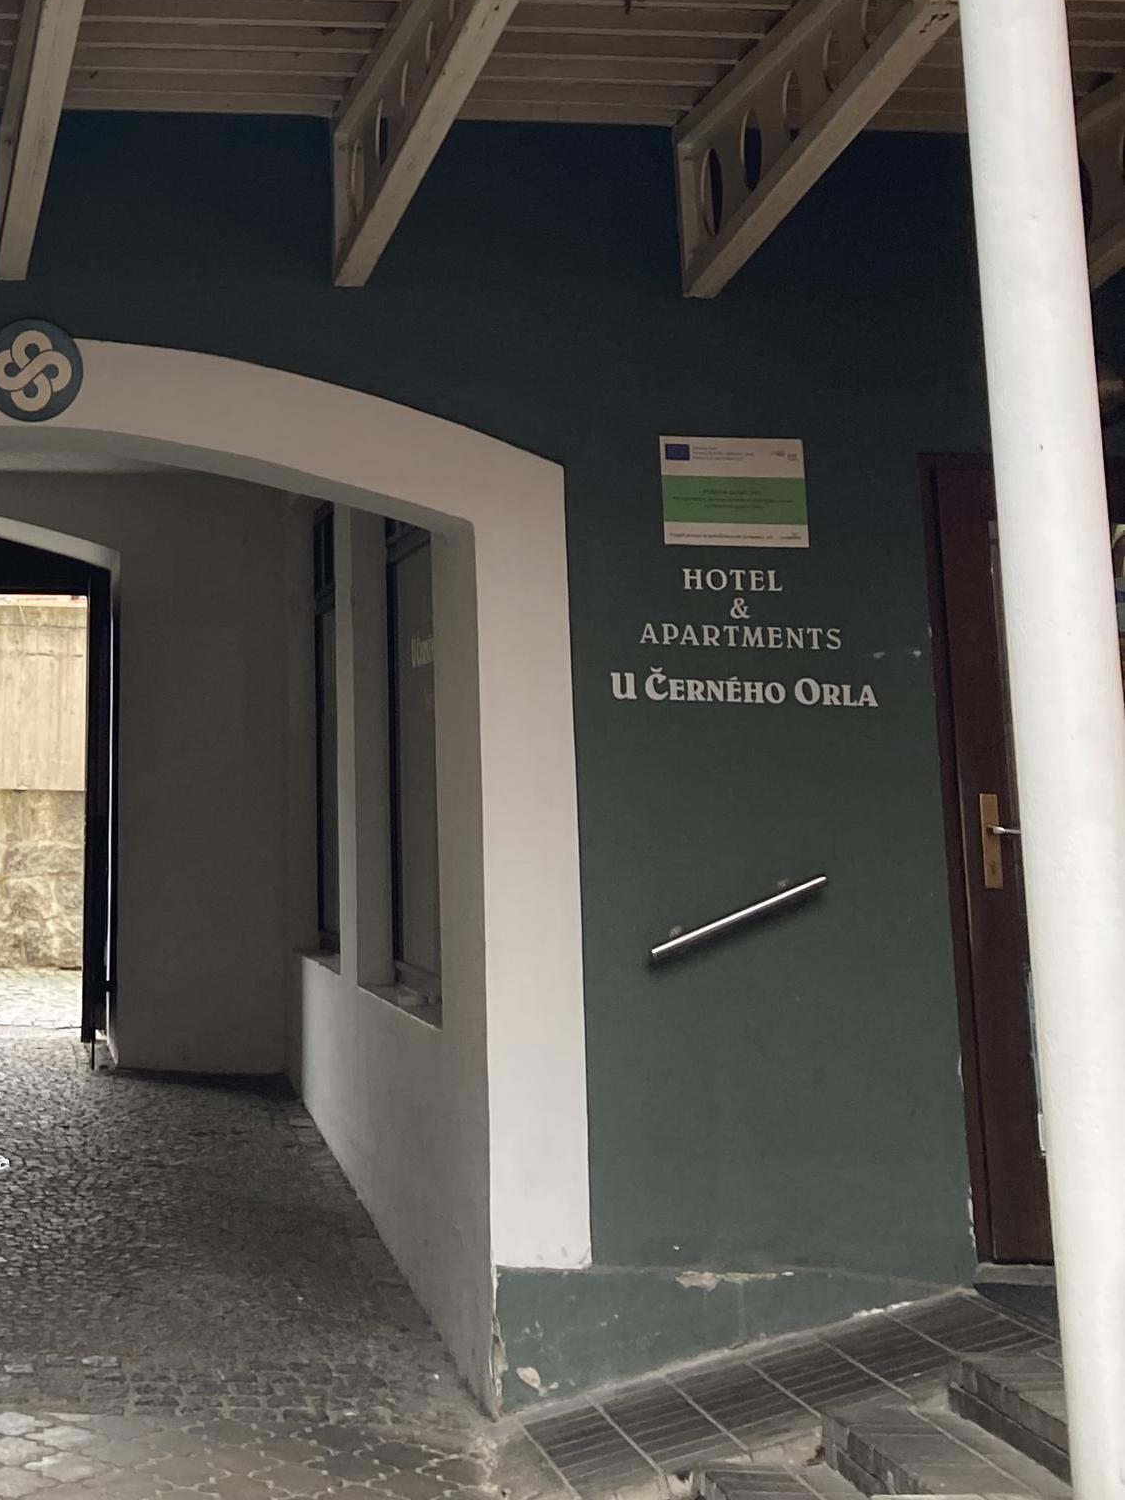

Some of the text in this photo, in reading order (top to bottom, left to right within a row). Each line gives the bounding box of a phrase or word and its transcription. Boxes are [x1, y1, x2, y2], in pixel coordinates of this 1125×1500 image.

[682, 567, 783, 592] HOTEL
[729, 596, 751, 620] &
[639, 622, 842, 650] APARTMENTS
[644, 666, 786, 704] ČERNÉHO
[793, 676, 879, 708] ORLA
